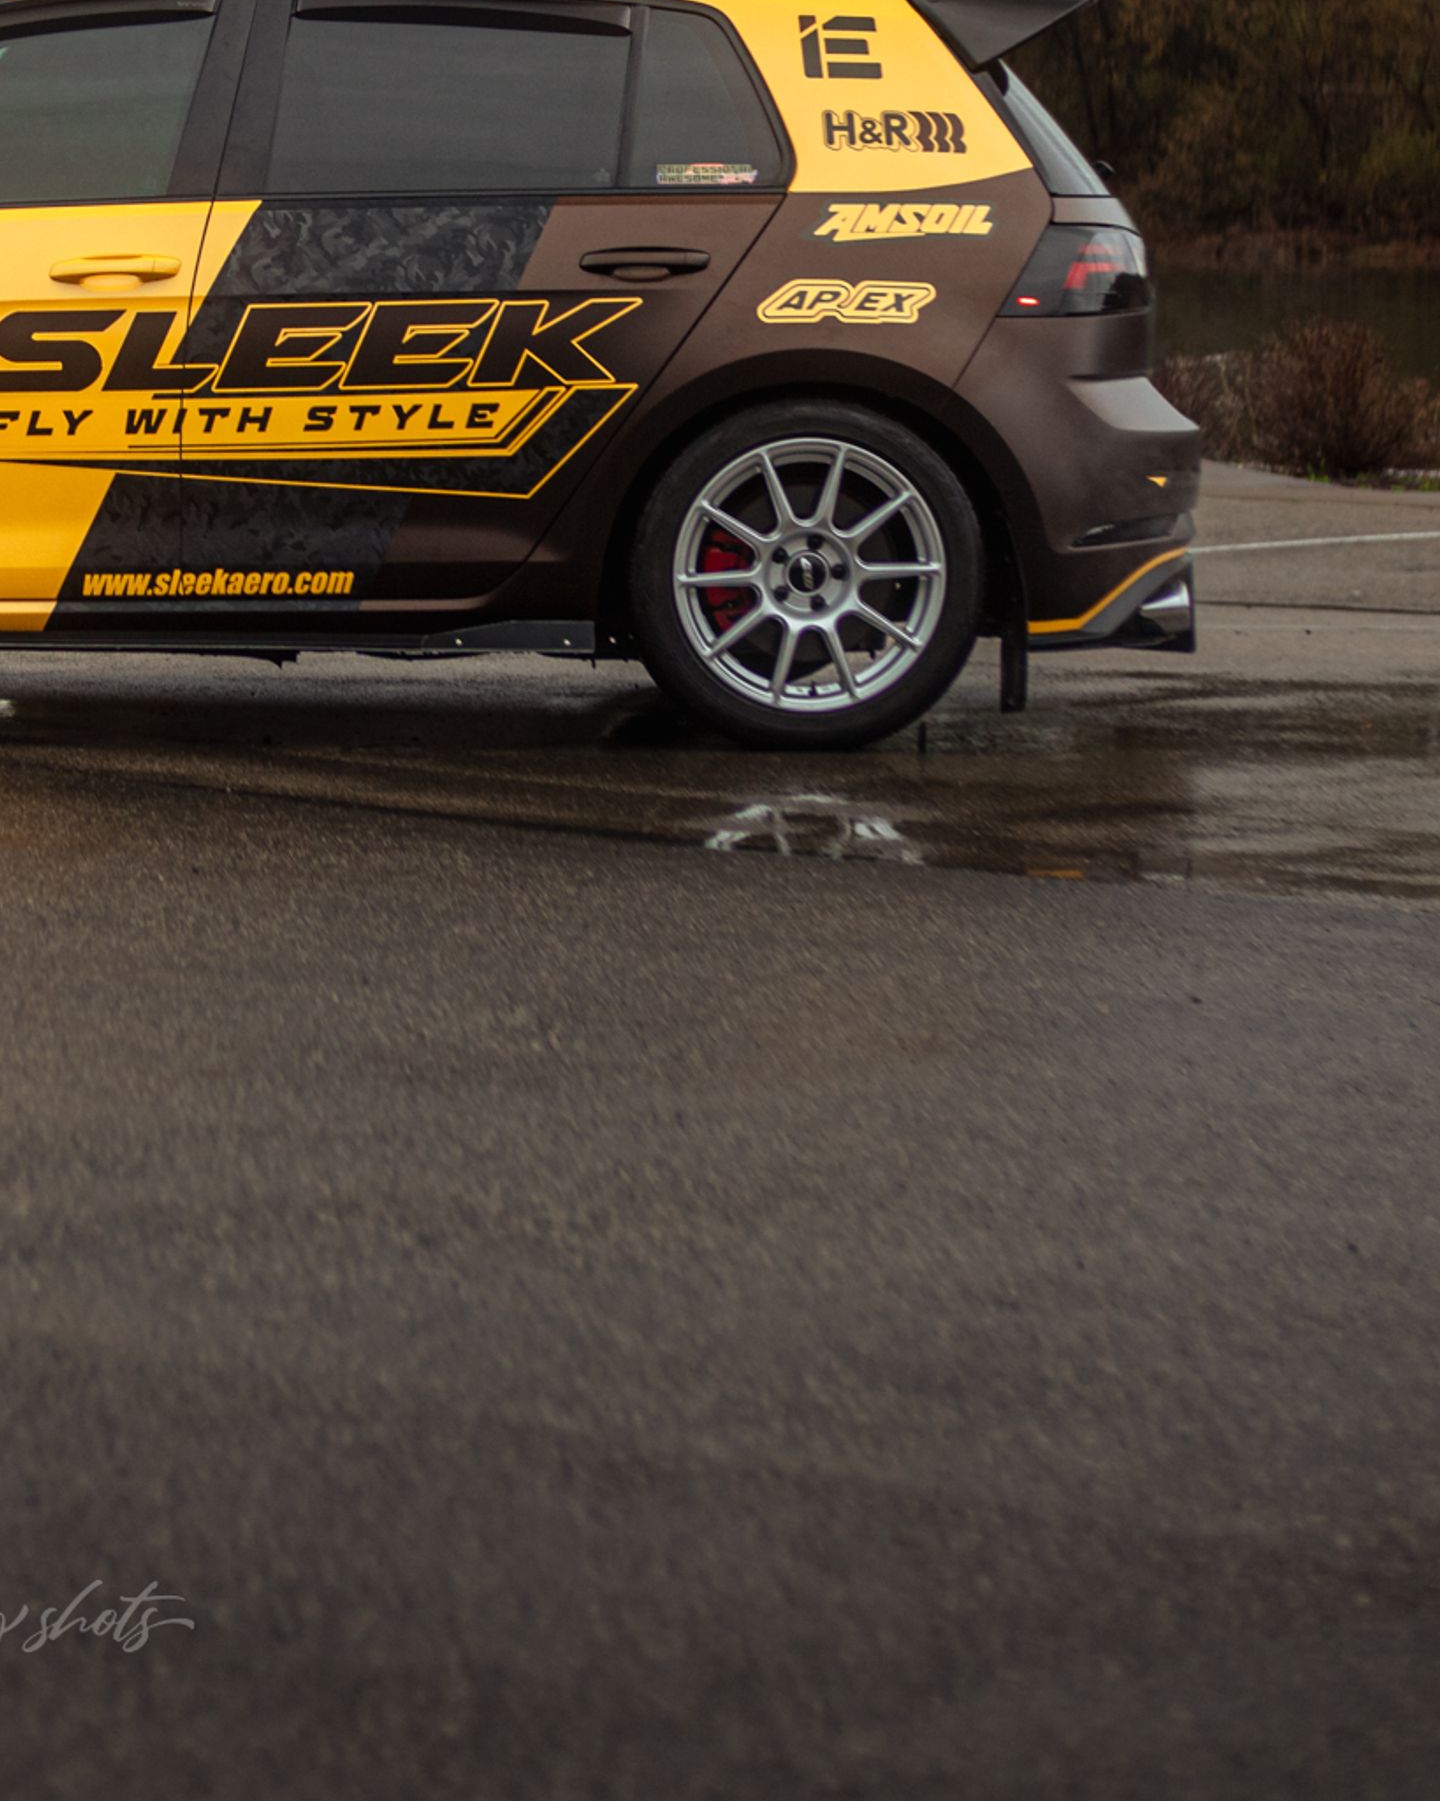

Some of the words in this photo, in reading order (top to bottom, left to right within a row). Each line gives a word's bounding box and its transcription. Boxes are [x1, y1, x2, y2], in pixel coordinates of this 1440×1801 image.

[814, 204, 993, 242] AMSOIL
[125, 406, 273, 435] WITH
[303, 403, 500, 432] STYLE
[82, 568, 354, 597] www.sleekaero.com
